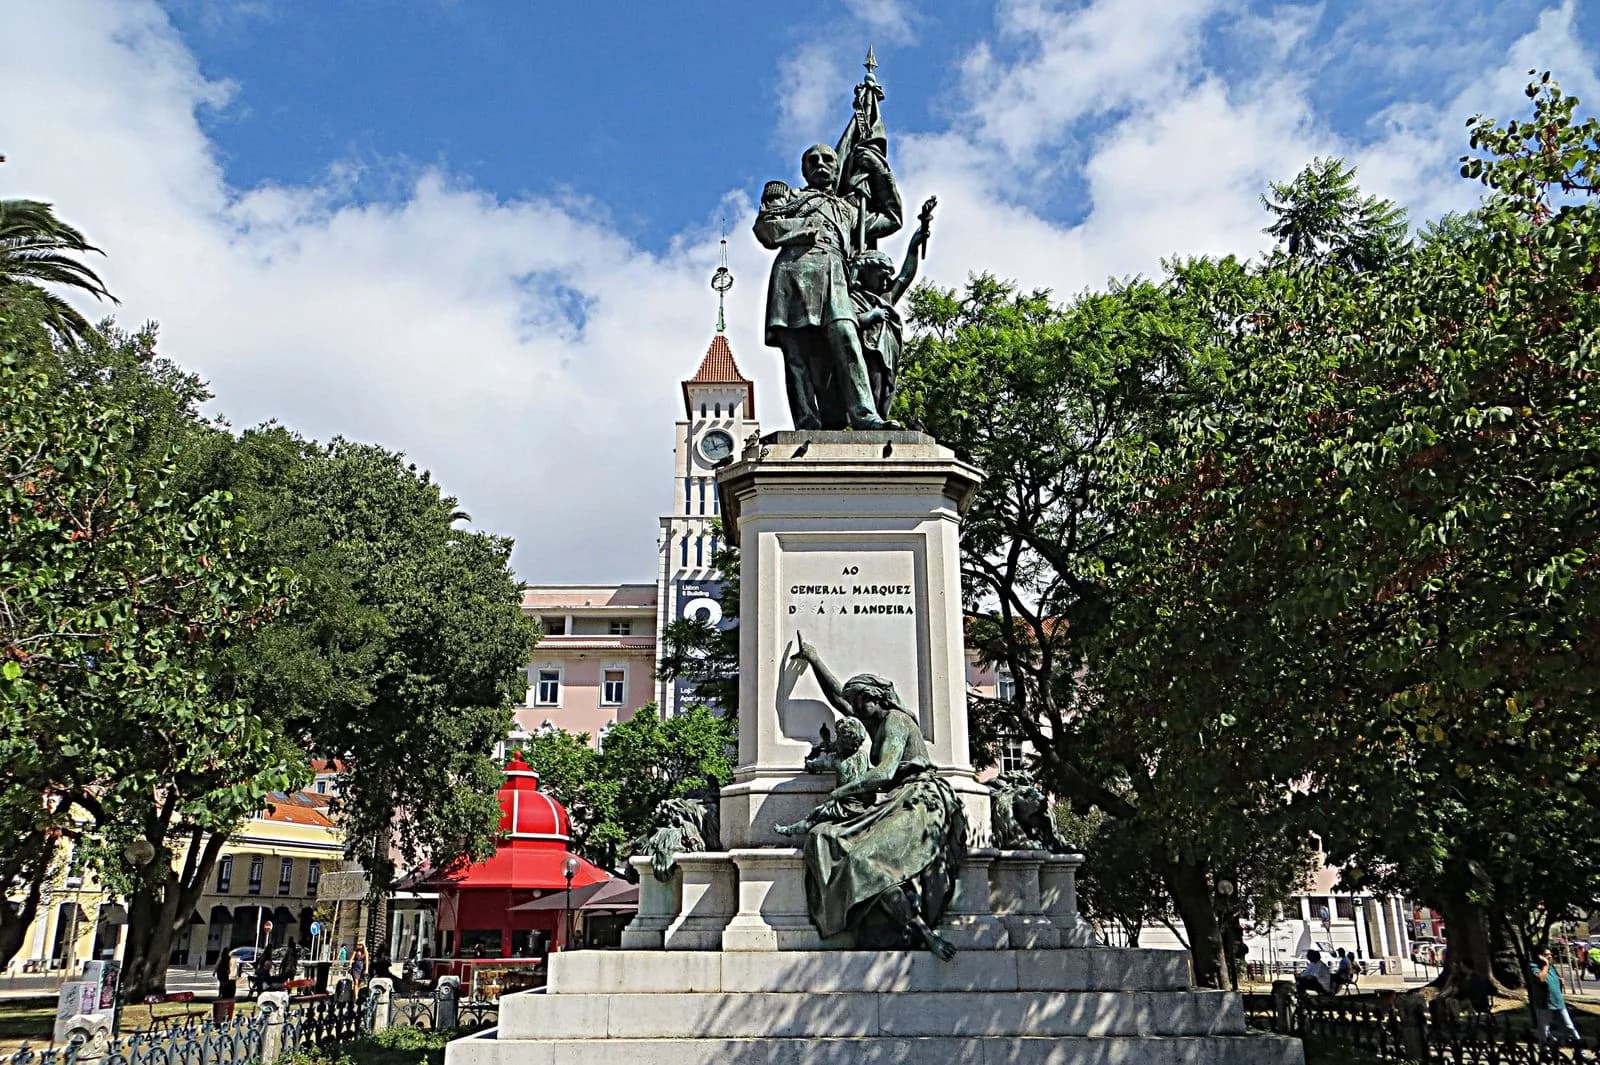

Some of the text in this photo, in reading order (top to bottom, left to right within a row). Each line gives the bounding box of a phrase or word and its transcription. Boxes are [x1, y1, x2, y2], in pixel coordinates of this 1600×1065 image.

[842, 566, 859, 575] AO
[790, 585, 911, 596] GENERAL MARQUEZ
[854, 605, 914, 614] BANDEIRA
